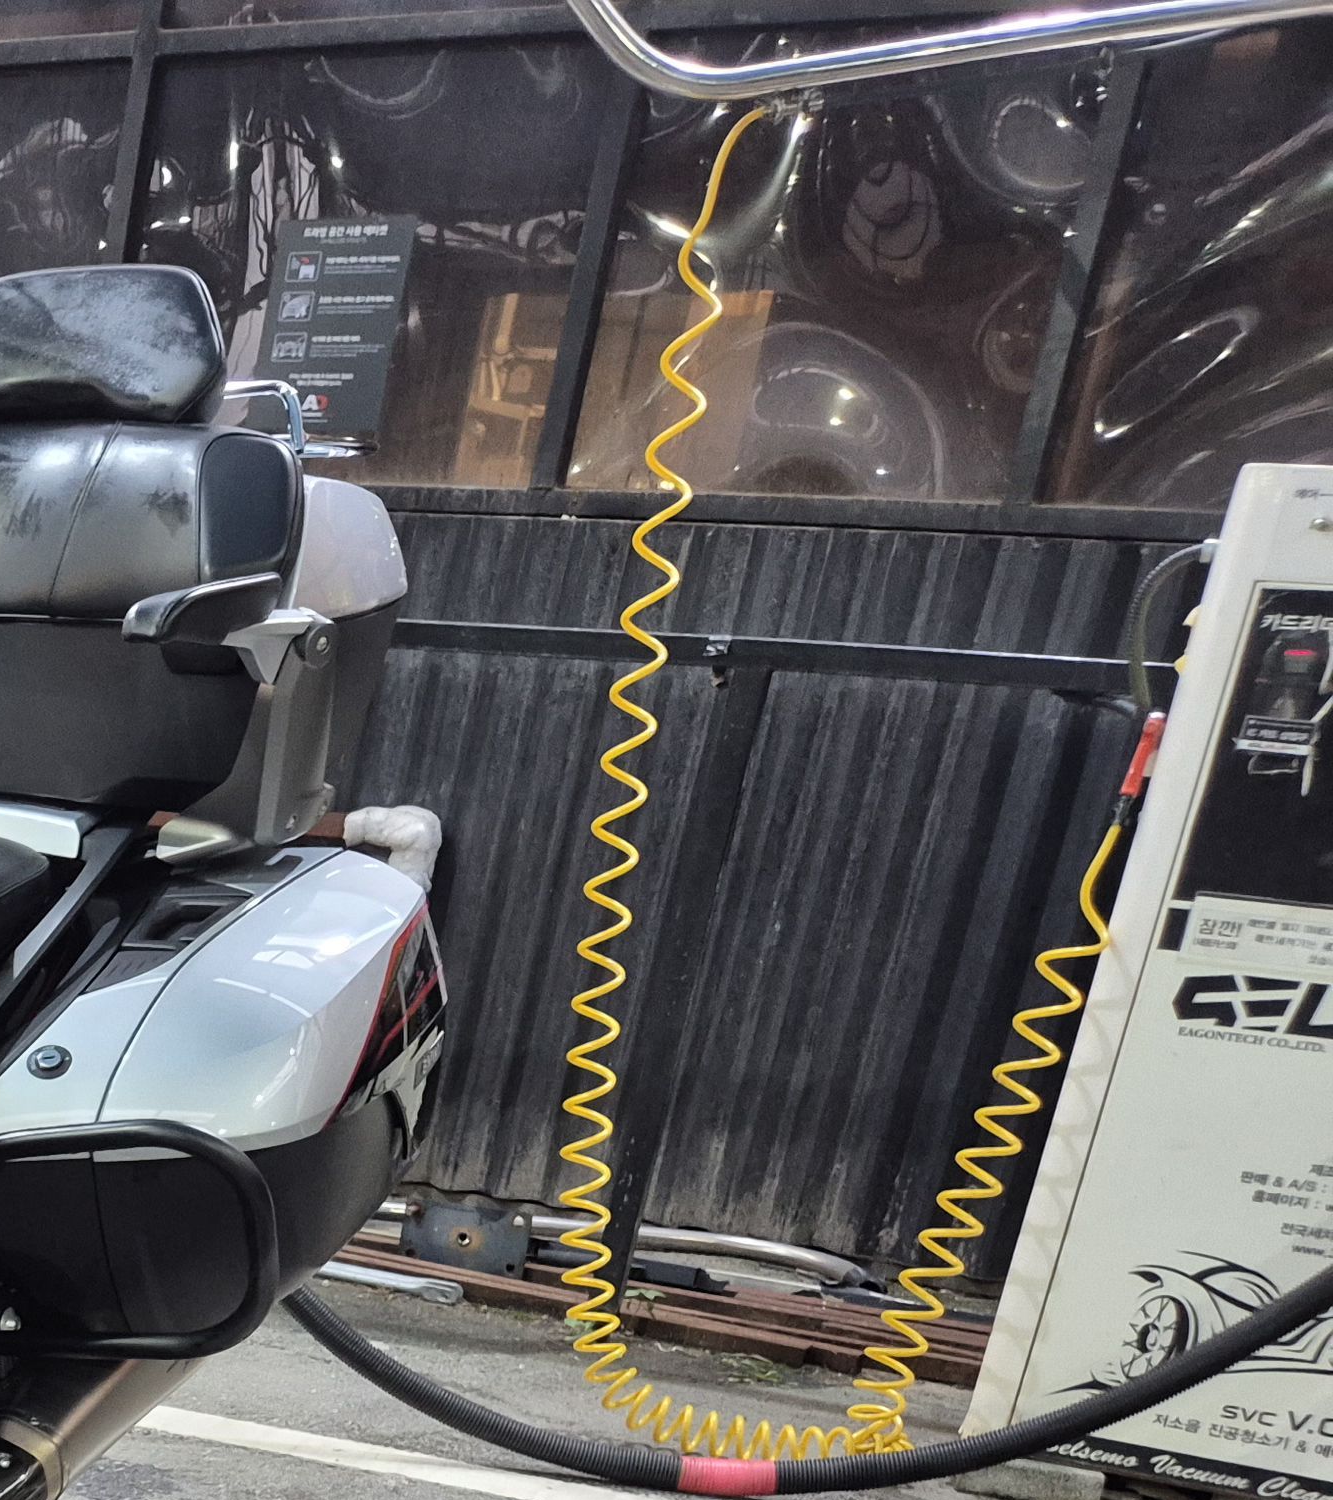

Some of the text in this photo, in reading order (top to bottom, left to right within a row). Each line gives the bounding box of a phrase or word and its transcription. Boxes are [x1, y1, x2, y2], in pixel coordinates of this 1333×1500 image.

[1178, 1026, 1264, 1046] EAGONTECH
[1152, 1413, 1201, 1434] 저소음
[1208, 1423, 1290, 1450] 진공청소기
[1314, 1444, 1333, 1459] 에
[1149, 1454, 1250, 1490] Vacuum
